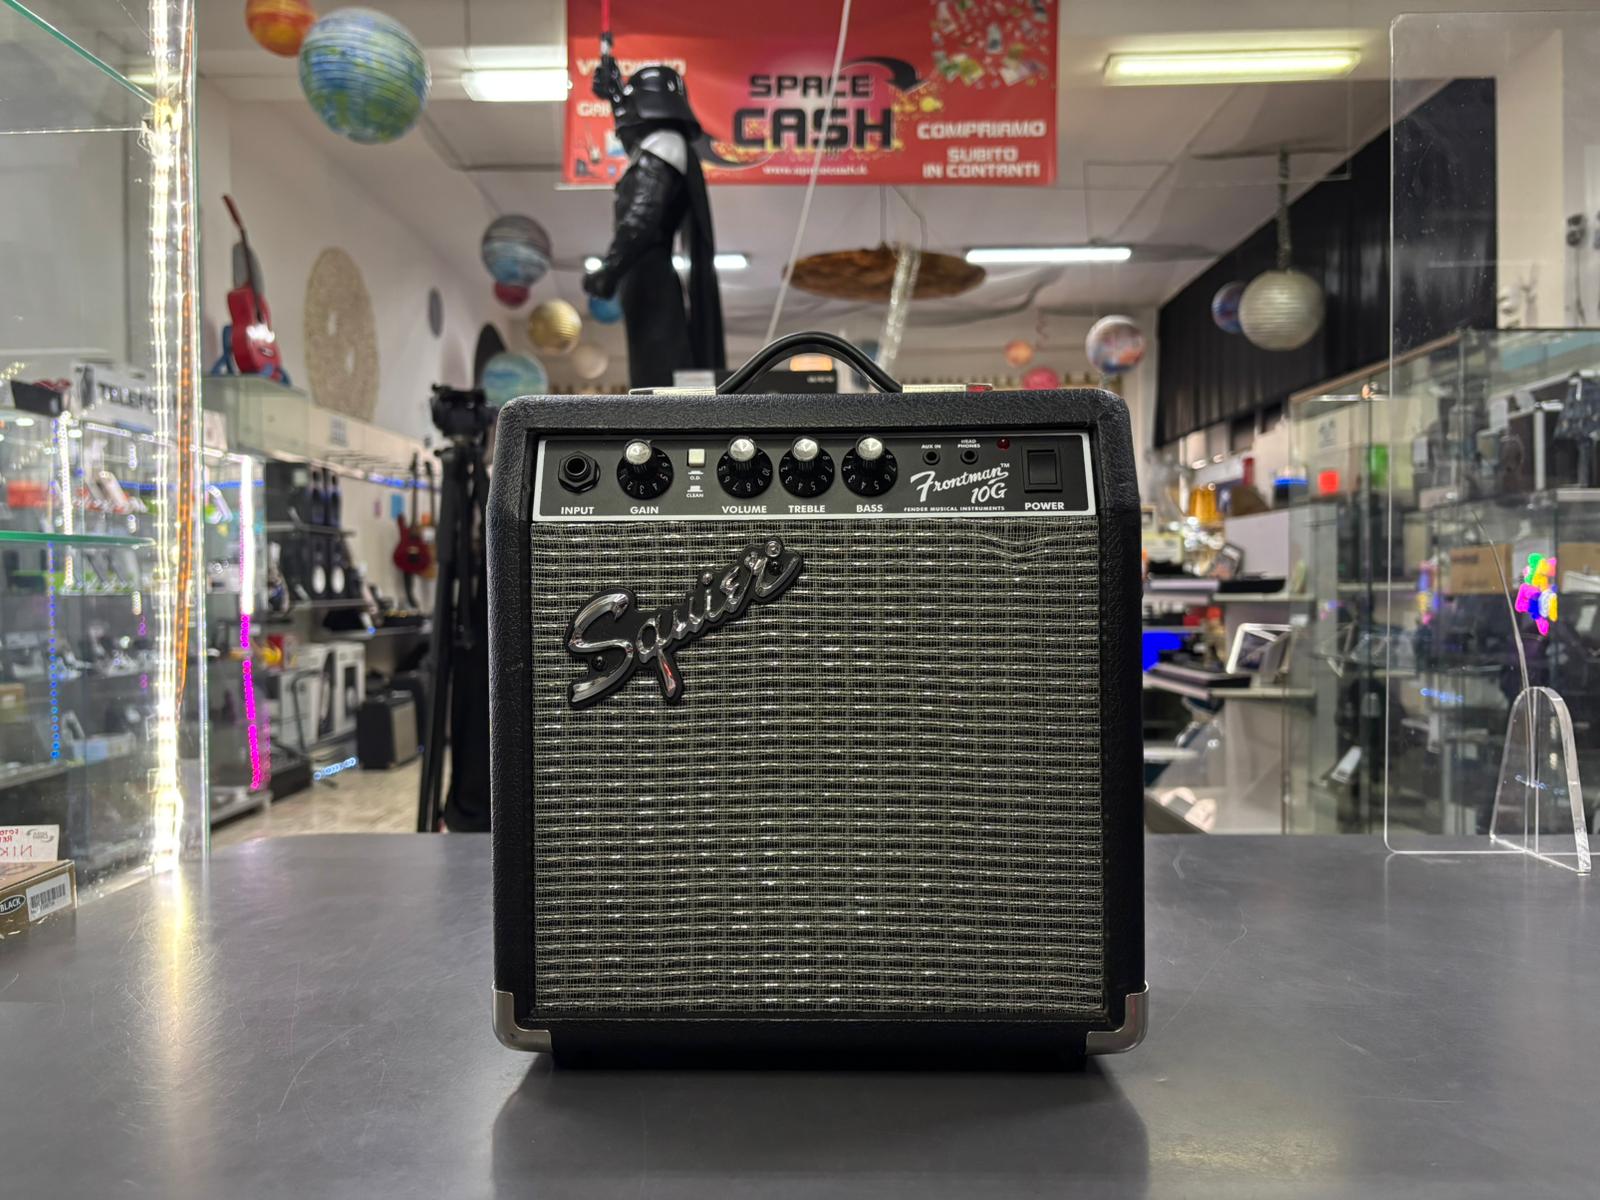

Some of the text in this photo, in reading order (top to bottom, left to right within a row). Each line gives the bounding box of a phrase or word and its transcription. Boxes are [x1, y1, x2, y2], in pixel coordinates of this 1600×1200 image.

[750, 74, 871, 97] SPACE
[734, 108, 892, 148] CASH
[917, 120, 1046, 139] COMPRIAMO
[947, 147, 1018, 162] SUBITO
[923, 162, 1040, 178] IN CONTANTI
[910, 466, 1009, 503] Frontman
[971, 482, 1008, 504] 10G
[561, 506, 595, 515] INPUT
[630, 505, 659, 515] GAIN
[721, 505, 768, 514] VOLUME
[788, 504, 826, 513] TREBLE
[856, 504, 883, 513] BASS
[1025, 501, 1065, 511] POWER
[566, 538, 802, 704] Squier
[0, 898, 21, 913] BLACK
